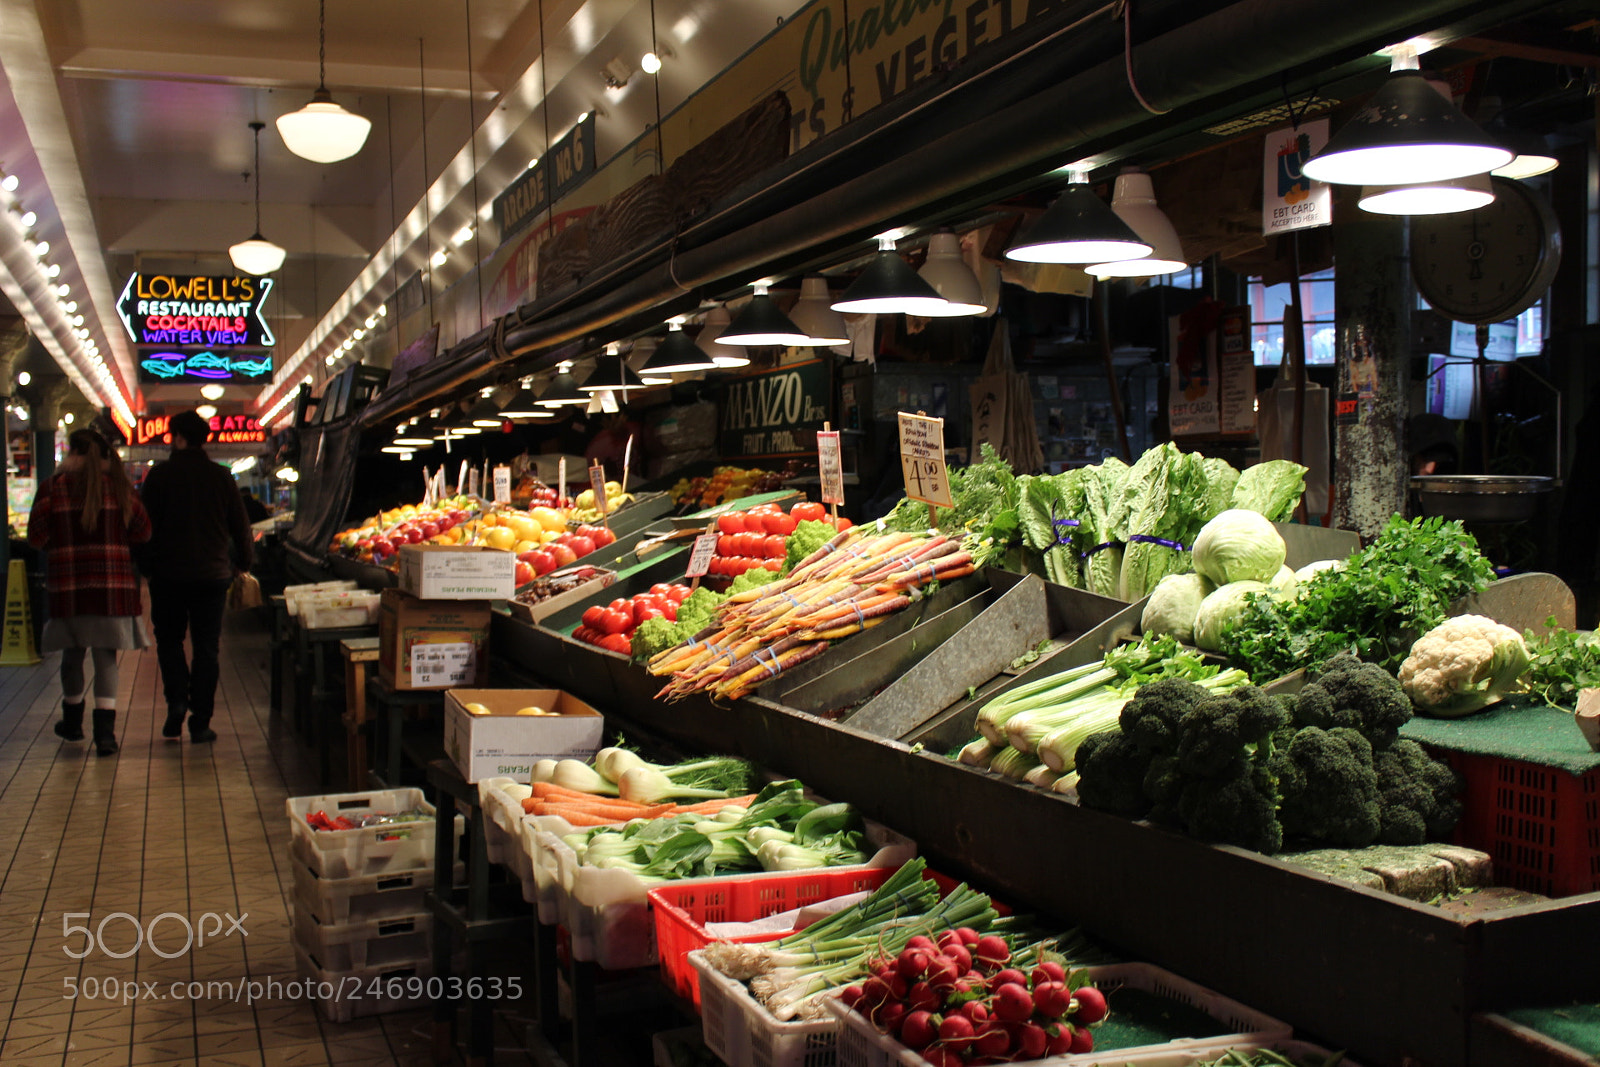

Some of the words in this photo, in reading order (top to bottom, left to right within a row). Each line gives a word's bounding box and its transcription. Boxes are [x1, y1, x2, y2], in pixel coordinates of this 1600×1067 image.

[503, 168, 545, 232] ARCADE
[573, 126, 584, 172] 6
[1273, 206, 1290, 219] EBT
[1291, 201, 1316, 215] CARD
[1271, 214, 1302, 228] ACCEPTED
[1302, 213, 1319, 224] HERE
[137, 275, 254, 300] LOWELL'S
[137, 300, 251, 317] RESTAURANT
[146, 315, 246, 333] COCKTAILS
[142, 329, 203, 344] WATER
[207, 330, 248, 346] VIEW
[723, 371, 803, 429] MANZO
[1173, 403, 1188, 416] EBT
[1189, 401, 1213, 415] CARD
[218, 431, 265, 442] ALWAYS
[742, 433, 766, 455] FRUIT
[497, 765, 530, 774] PEARS
